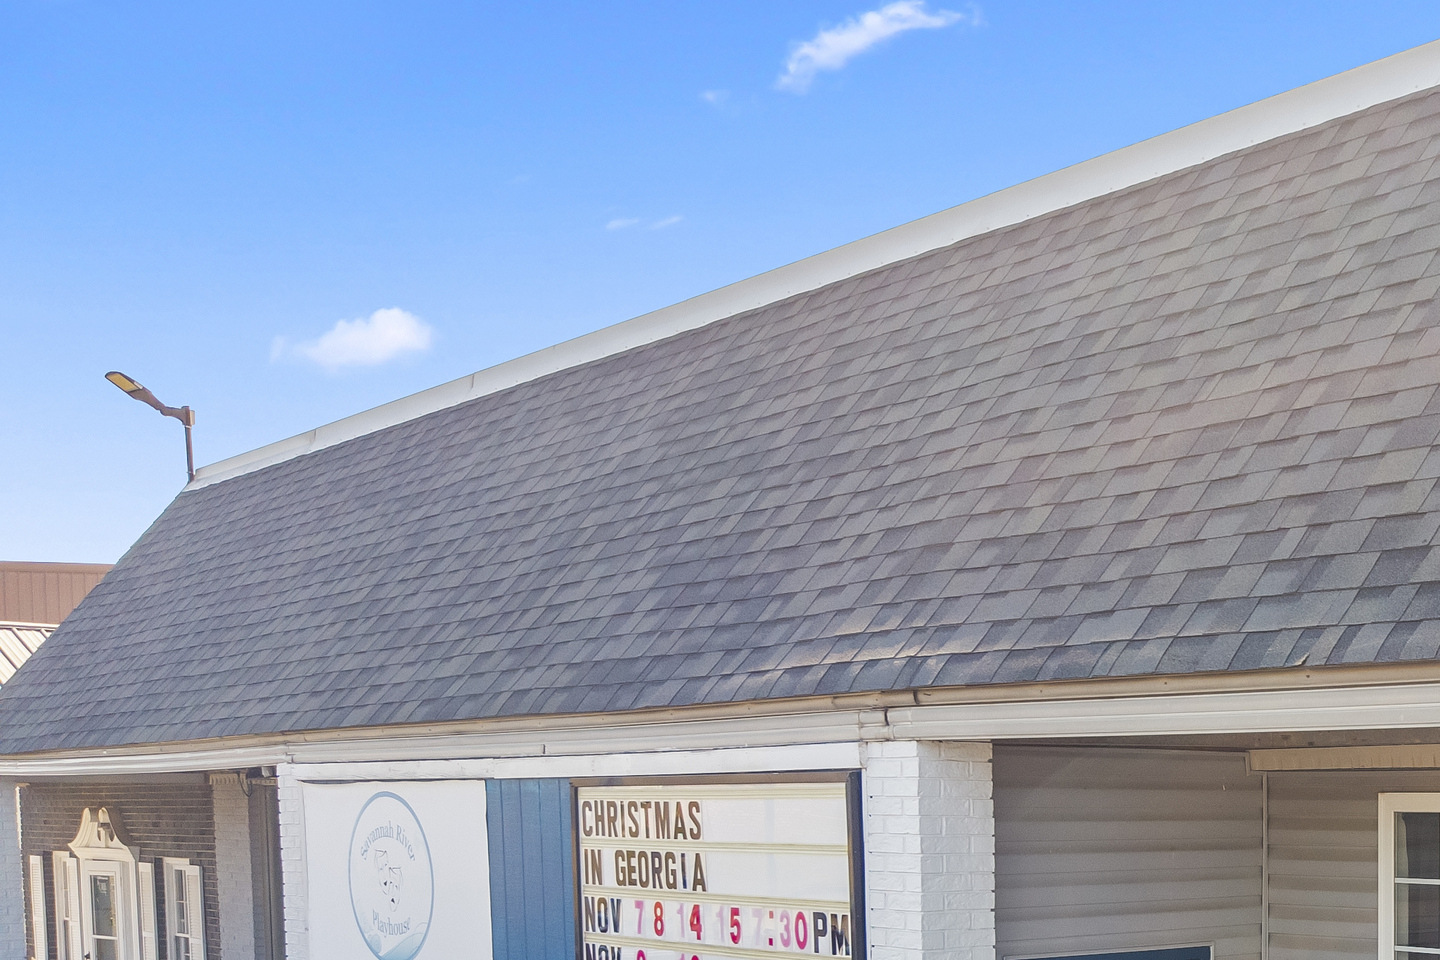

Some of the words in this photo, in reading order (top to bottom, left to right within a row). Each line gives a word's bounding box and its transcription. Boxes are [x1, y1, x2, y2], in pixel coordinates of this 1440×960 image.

[361, 820, 394, 860] Savannah
[396, 824, 416, 861] River
[582, 800, 701, 840] CHRISTMAS
[584, 848, 602, 885] IN
[614, 849, 707, 891] GEORGIA
[372, 909, 411, 938] Playhouse
[584, 897, 622, 933] NOV
[634, 900, 644, 934] 7
[653, 901, 664, 936] 8
[677, 902, 702, 940] 14
